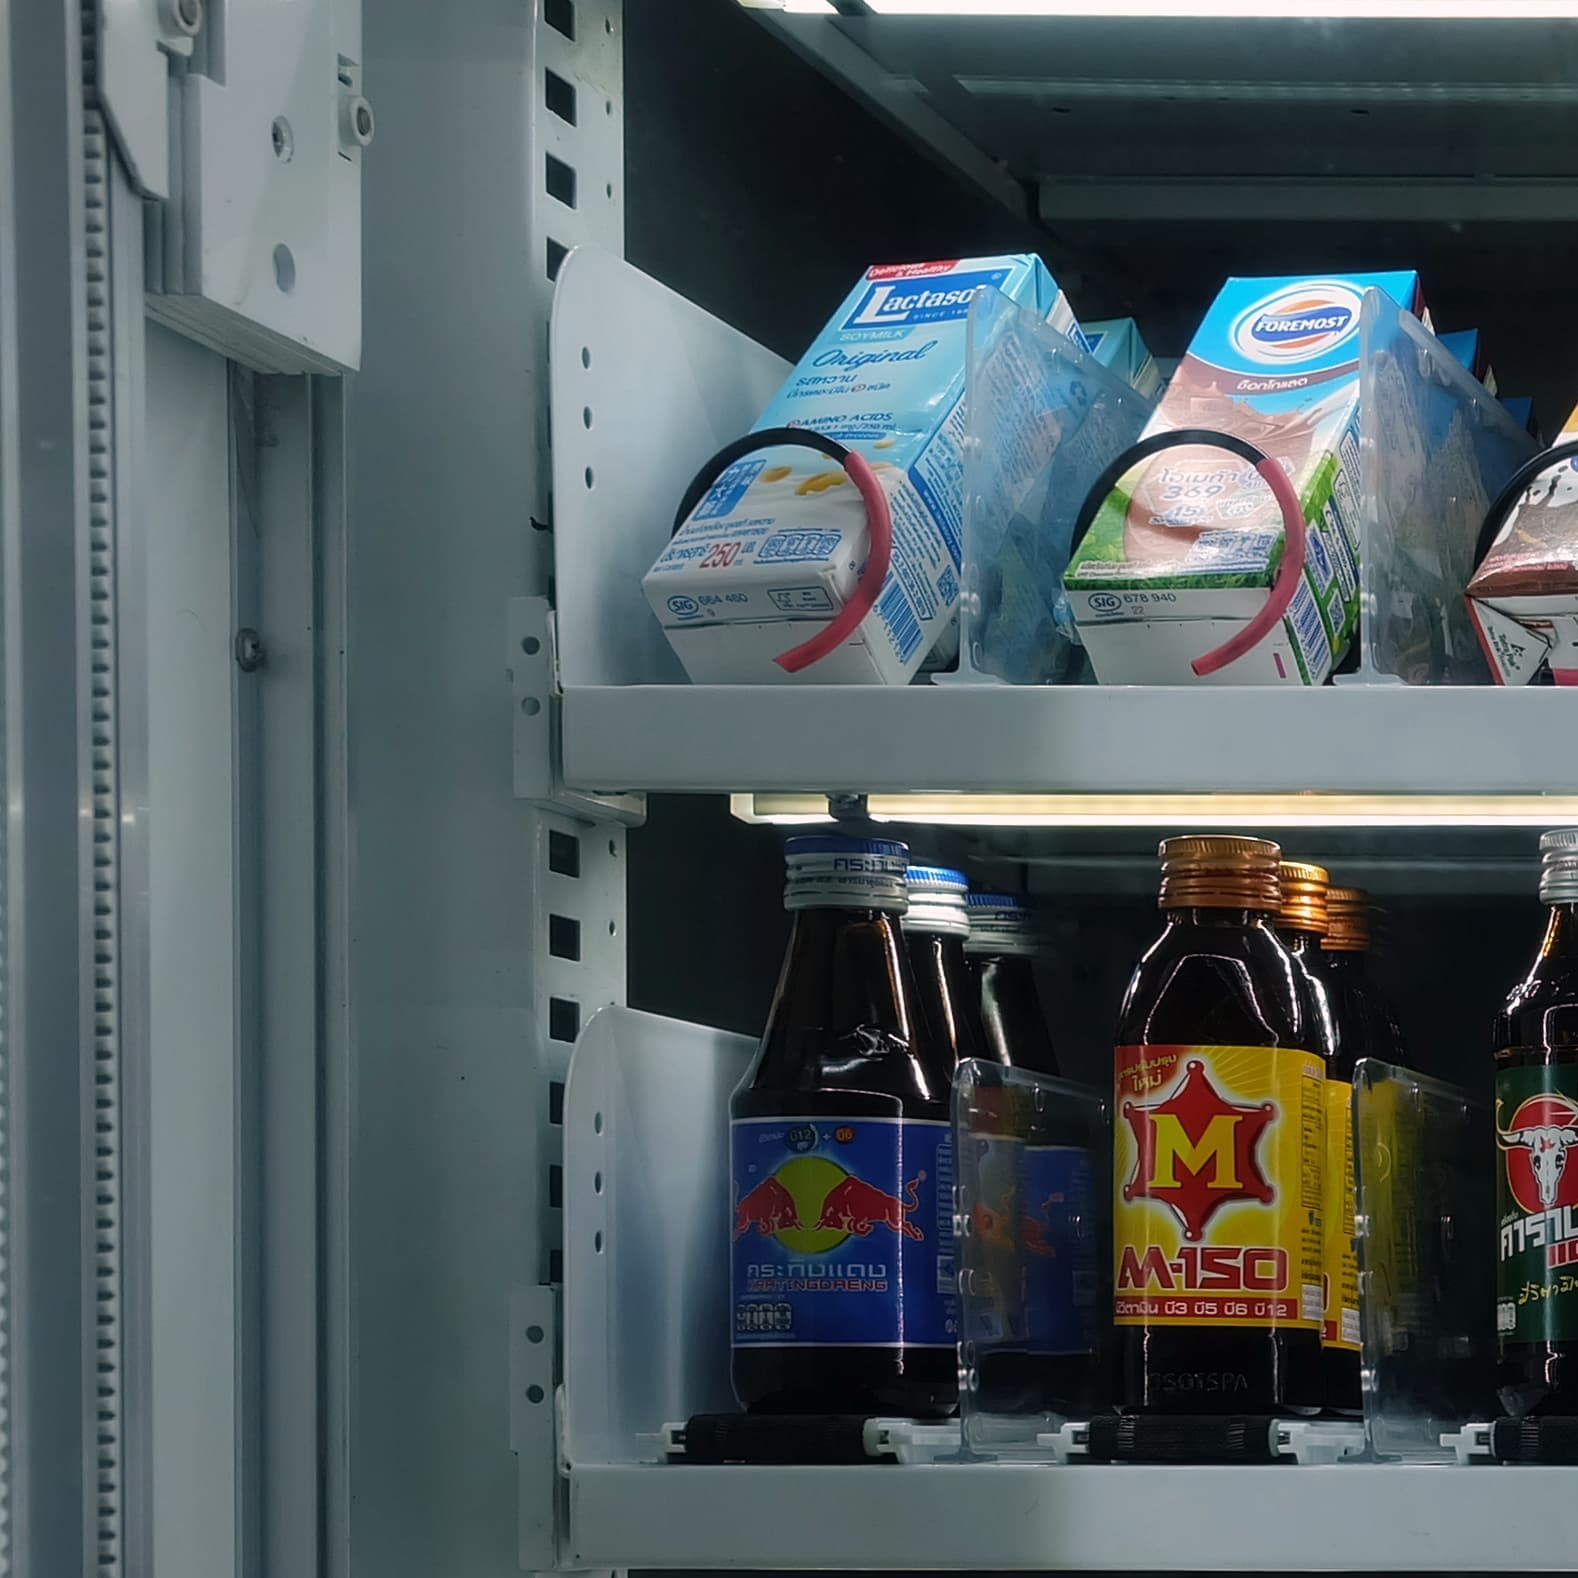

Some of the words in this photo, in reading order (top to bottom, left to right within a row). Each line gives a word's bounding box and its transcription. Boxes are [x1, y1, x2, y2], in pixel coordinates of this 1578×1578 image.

[853, 284, 986, 324] Lactaso
[1256, 314, 1349, 333] FOREMOST
[839, 329, 905, 342] SOYMILK
[812, 340, 939, 372] Original
[849, 412, 894, 423] ACIDS
[1164, 485, 1223, 499] 369
[699, 541, 742, 569] 250
[1094, 597, 1116, 609] SIG
[1148, 1114, 1244, 1188] M
[1115, 1246, 1289, 1292] M-150
[1164, 1299, 1188, 1316] บี3
[1194, 1300, 1218, 1316] บี5
[1224, 1300, 1248, 1316] บี6
[1255, 1301, 1288, 1317] บี12
